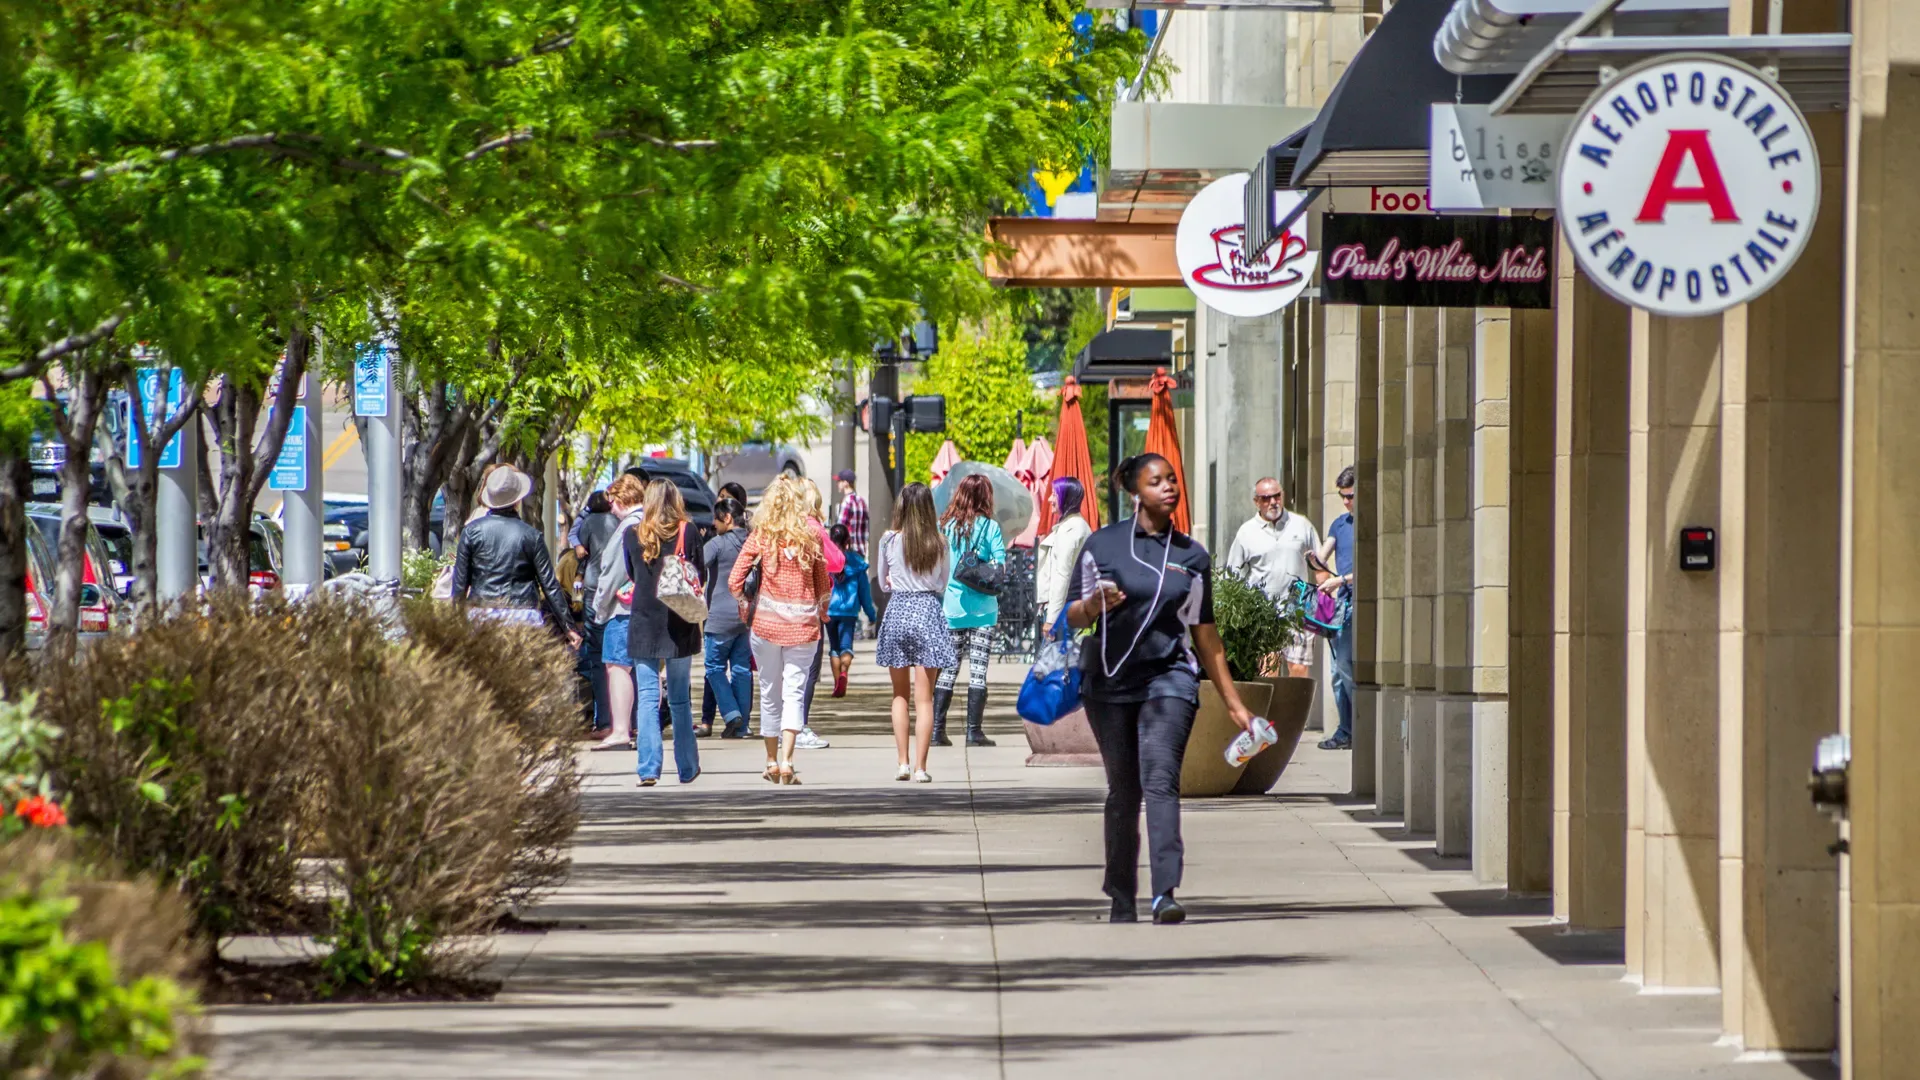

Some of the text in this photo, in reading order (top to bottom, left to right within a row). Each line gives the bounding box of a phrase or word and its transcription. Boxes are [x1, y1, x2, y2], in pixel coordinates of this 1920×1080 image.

[1578, 71, 1801, 169] AÉROPOSTALE
[1449, 126, 1551, 162] bliss
[1460, 164, 1514, 183] med
[1634, 129, 1742, 225] A
[1231, 267, 1269, 284] Press
[1327, 236, 1548, 283] Pink & White Nails
[1577, 208, 1799, 302] AÉROPOSTALE
